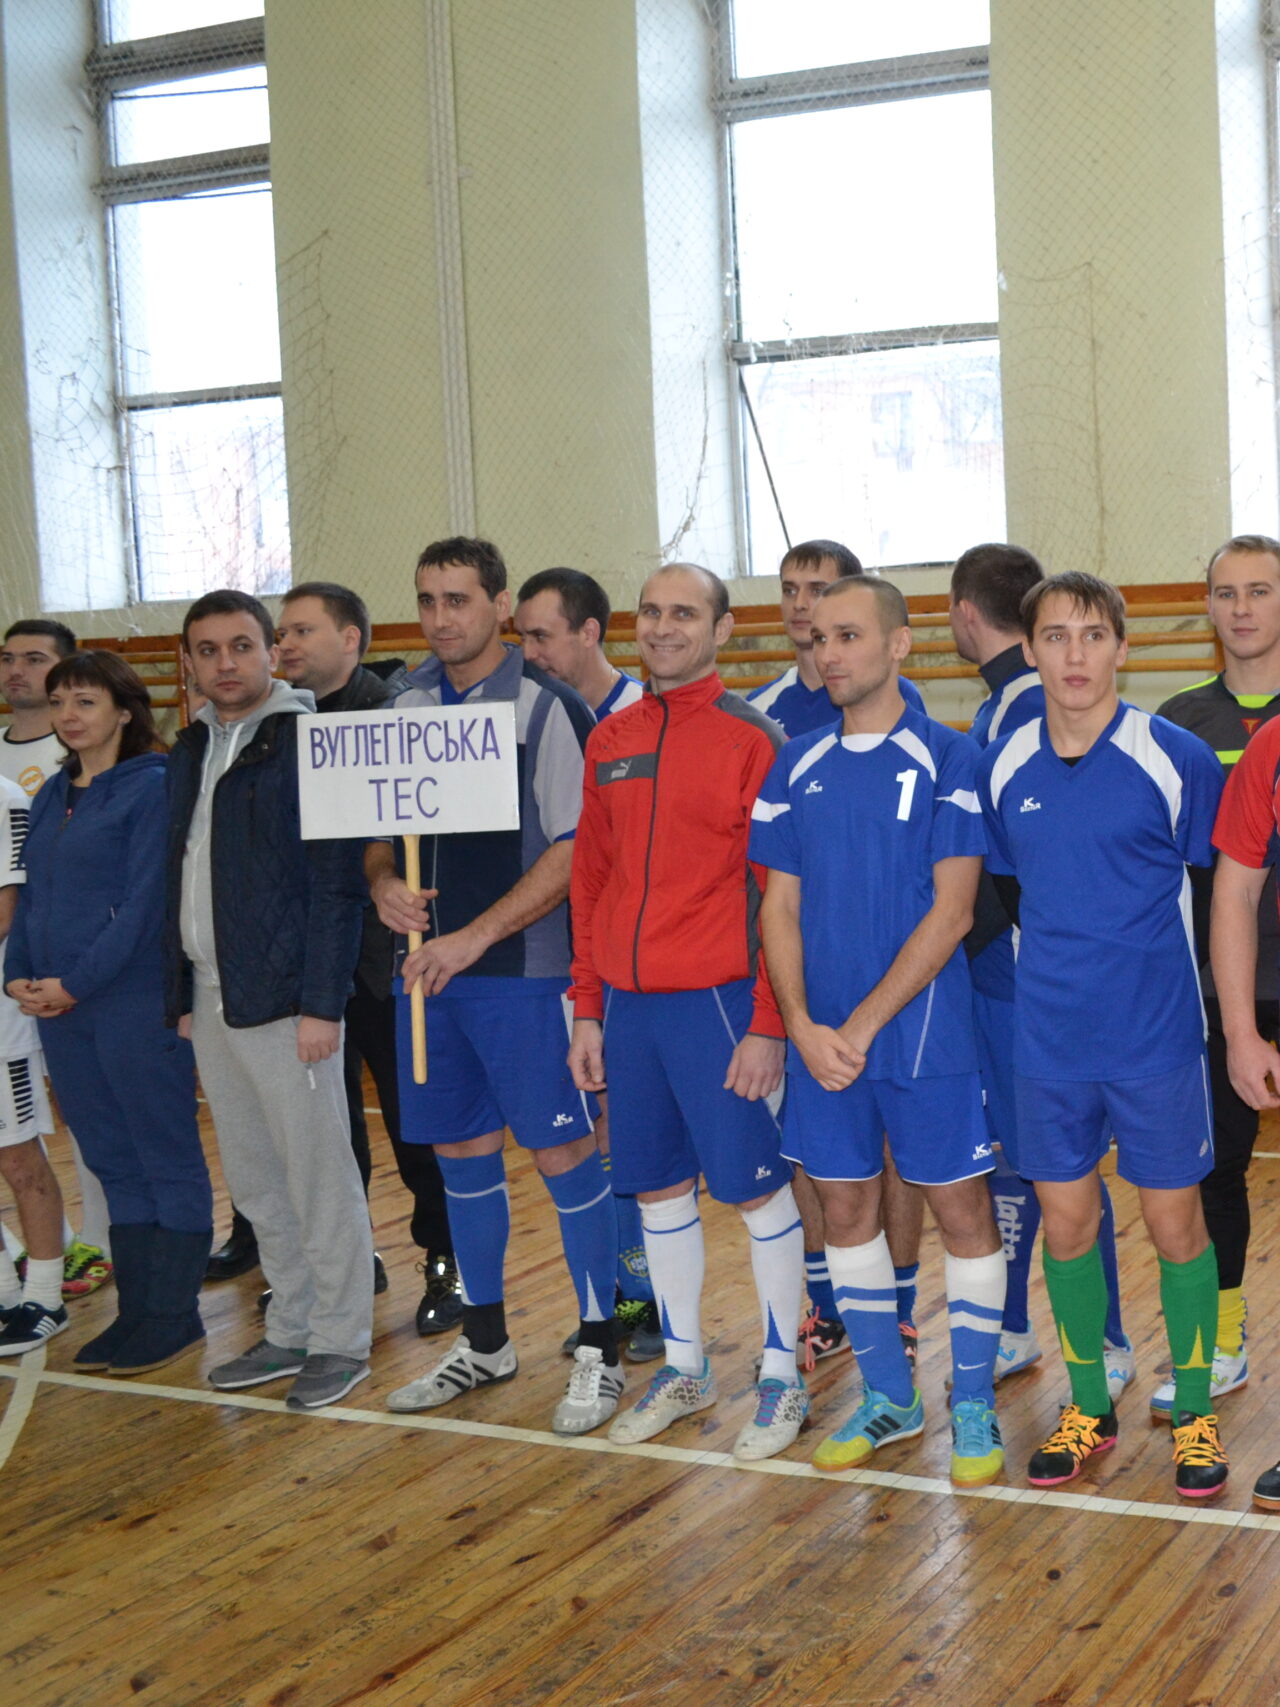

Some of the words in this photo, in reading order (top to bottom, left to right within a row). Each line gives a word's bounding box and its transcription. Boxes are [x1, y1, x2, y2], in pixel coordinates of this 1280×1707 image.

[309, 716, 501, 769] ВУГЛЕГІРСЬКА
[368, 776, 440, 821] ТЕС
[895, 768, 919, 822] 1
